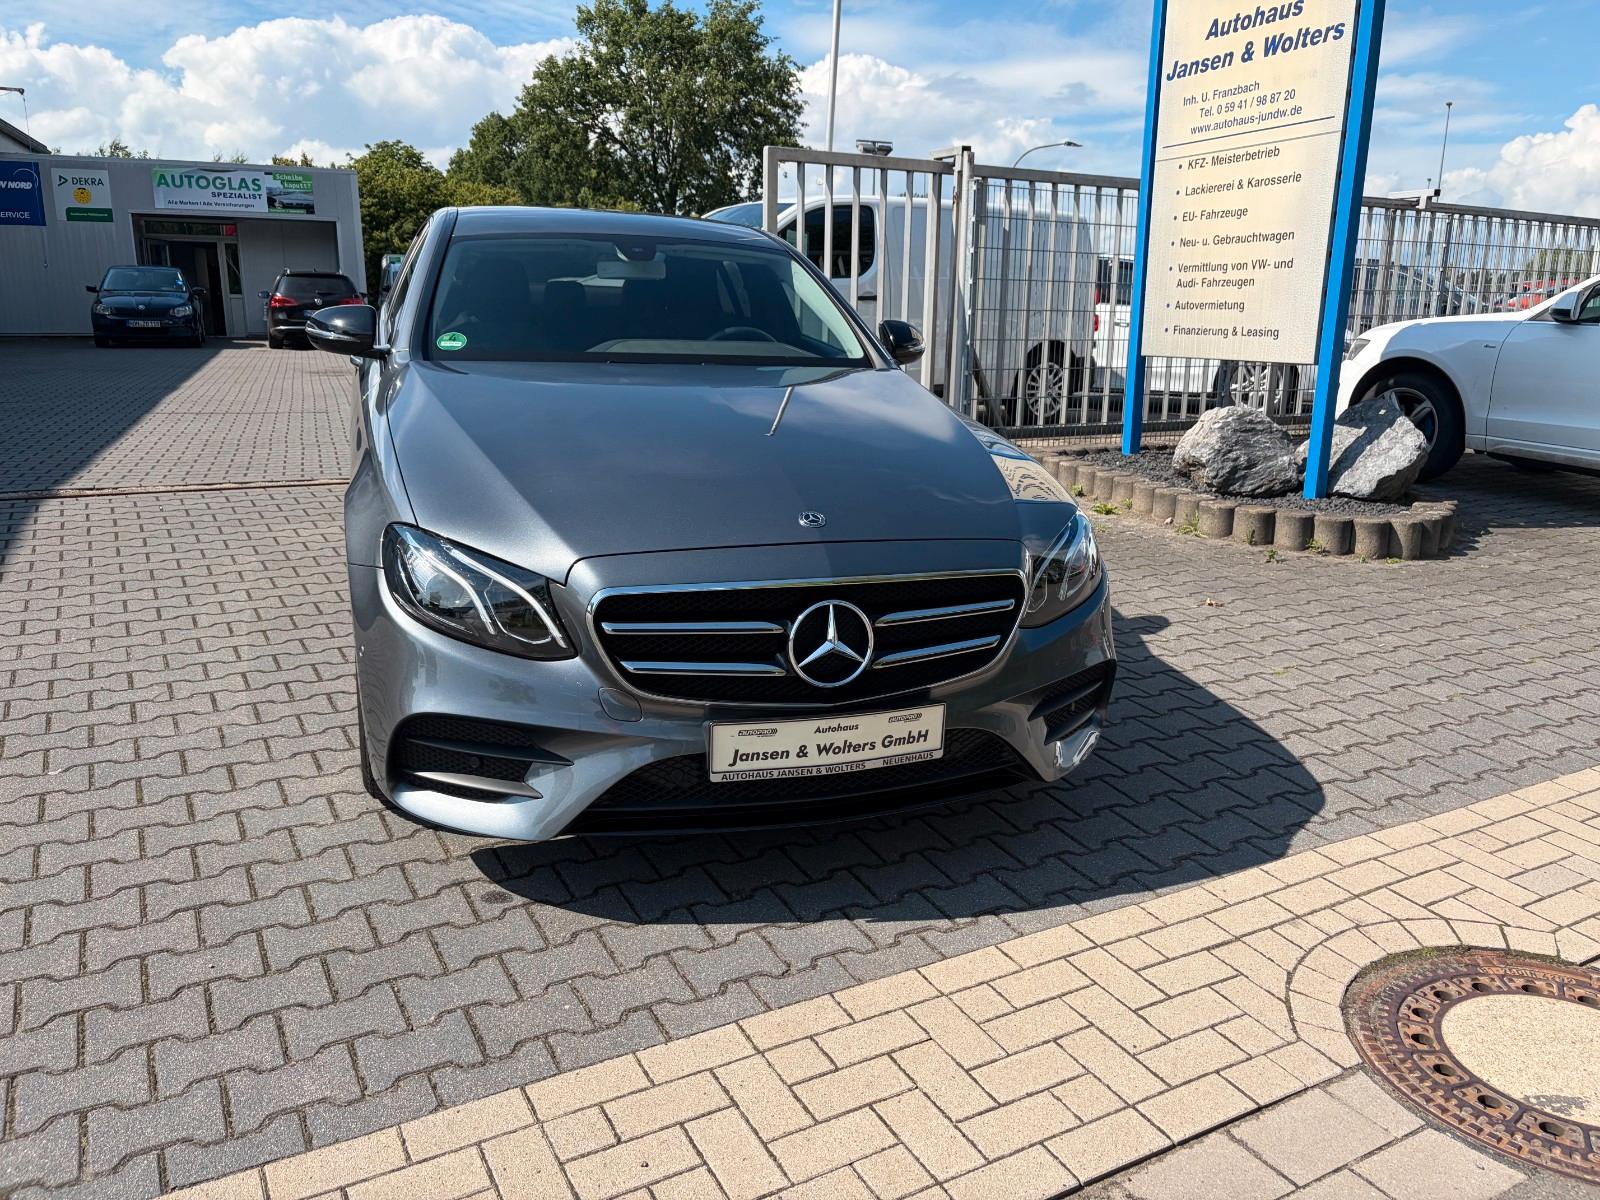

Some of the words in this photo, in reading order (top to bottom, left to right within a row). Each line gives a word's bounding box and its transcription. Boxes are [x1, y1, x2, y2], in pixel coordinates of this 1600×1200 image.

[1204, 0, 1304, 41] Autohaus
[1166, 50, 1234, 82] Jansen
[1240, 40, 1255, 63] &
[1263, 22, 1346, 58] Wolters
[1183, 94, 1199, 106] Inh.
[1201, 91, 1211, 103] U.
[1212, 80, 1260, 100] Franzbach
[1199, 106, 1214, 119] Tel.
[1217, 104, 1223, 115] 0
[1224, 101, 1236, 113] 59
[1237, 98, 1248, 111] 41
[1249, 97, 1254, 109] /
[1256, 94, 1268, 107] 98
[1269, 91, 1281, 104] 87
[1283, 88, 1296, 102] 20
[1190, 104, 1303, 136] www.autohaus-jundw.de
[1187, 158, 1209, 170] KFZ-
[1211, 145, 1281, 167] Meisterbetrieb
[8, 181, 33, 190] NORD
[71, 176, 104, 187] DEKRA
[156, 173, 262, 192] AUTOGLAS
[1184, 180, 1235, 197] Lackiererei
[1236, 178, 1244, 190] &
[1247, 171, 1302, 188] Karosserie
[210, 191, 263, 200] SPEZIALIST
[1182, 211, 1198, 222] EU-
[1200, 206, 1249, 221] Fahrzeuge
[1179, 236, 1200, 248] Neu-
[1202, 236, 1210, 247] u.
[1212, 229, 1295, 246] Gebrauchtwagen
[1178, 261, 1228, 274] Vermittlung
[1231, 260, 1248, 271] von
[1251, 259, 1271, 270] VW-
[1273, 257, 1294, 270] und
[1176, 277, 1199, 288] Audi-
[1201, 277, 1255, 288] Fahrzeugen
[1174, 299, 1245, 313] Autovermietung
[1173, 324, 1229, 338] Finanzierung
[1231, 326, 1238, 337] &
[1241, 326, 1280, 340] Leasing
[814, 722, 859, 735] Autohaus
[728, 747, 790, 767] Jansen
[795, 744, 809, 758] &
[815, 739, 876, 757] Wolters
[881, 729, 929, 749] GmbH
[720, 770, 774, 782] AUTOHAUS
[775, 767, 813, 778] JANSEN
[815, 766, 823, 775] &
[825, 761, 866, 774] WOLTERS
[882, 751, 934, 767] NEUENHAUS
